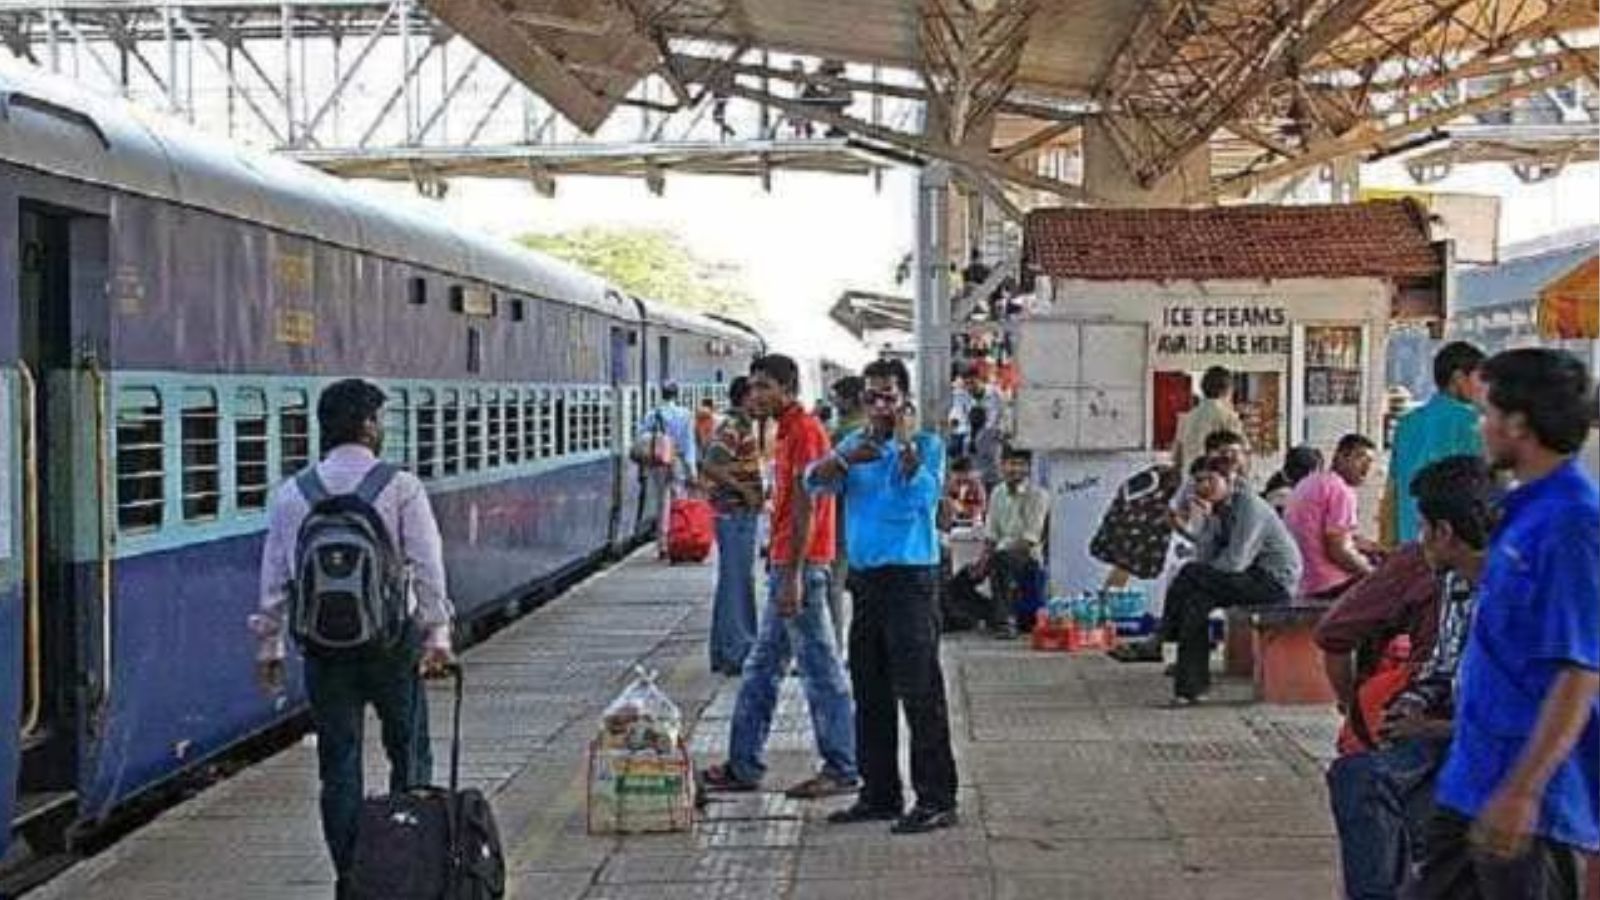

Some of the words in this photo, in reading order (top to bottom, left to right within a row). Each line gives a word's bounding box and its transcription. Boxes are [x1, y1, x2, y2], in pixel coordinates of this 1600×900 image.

[1163, 306, 1193, 327] ICE
[1203, 306, 1286, 327] CREAMS
[1250, 335, 1292, 355] HERE
